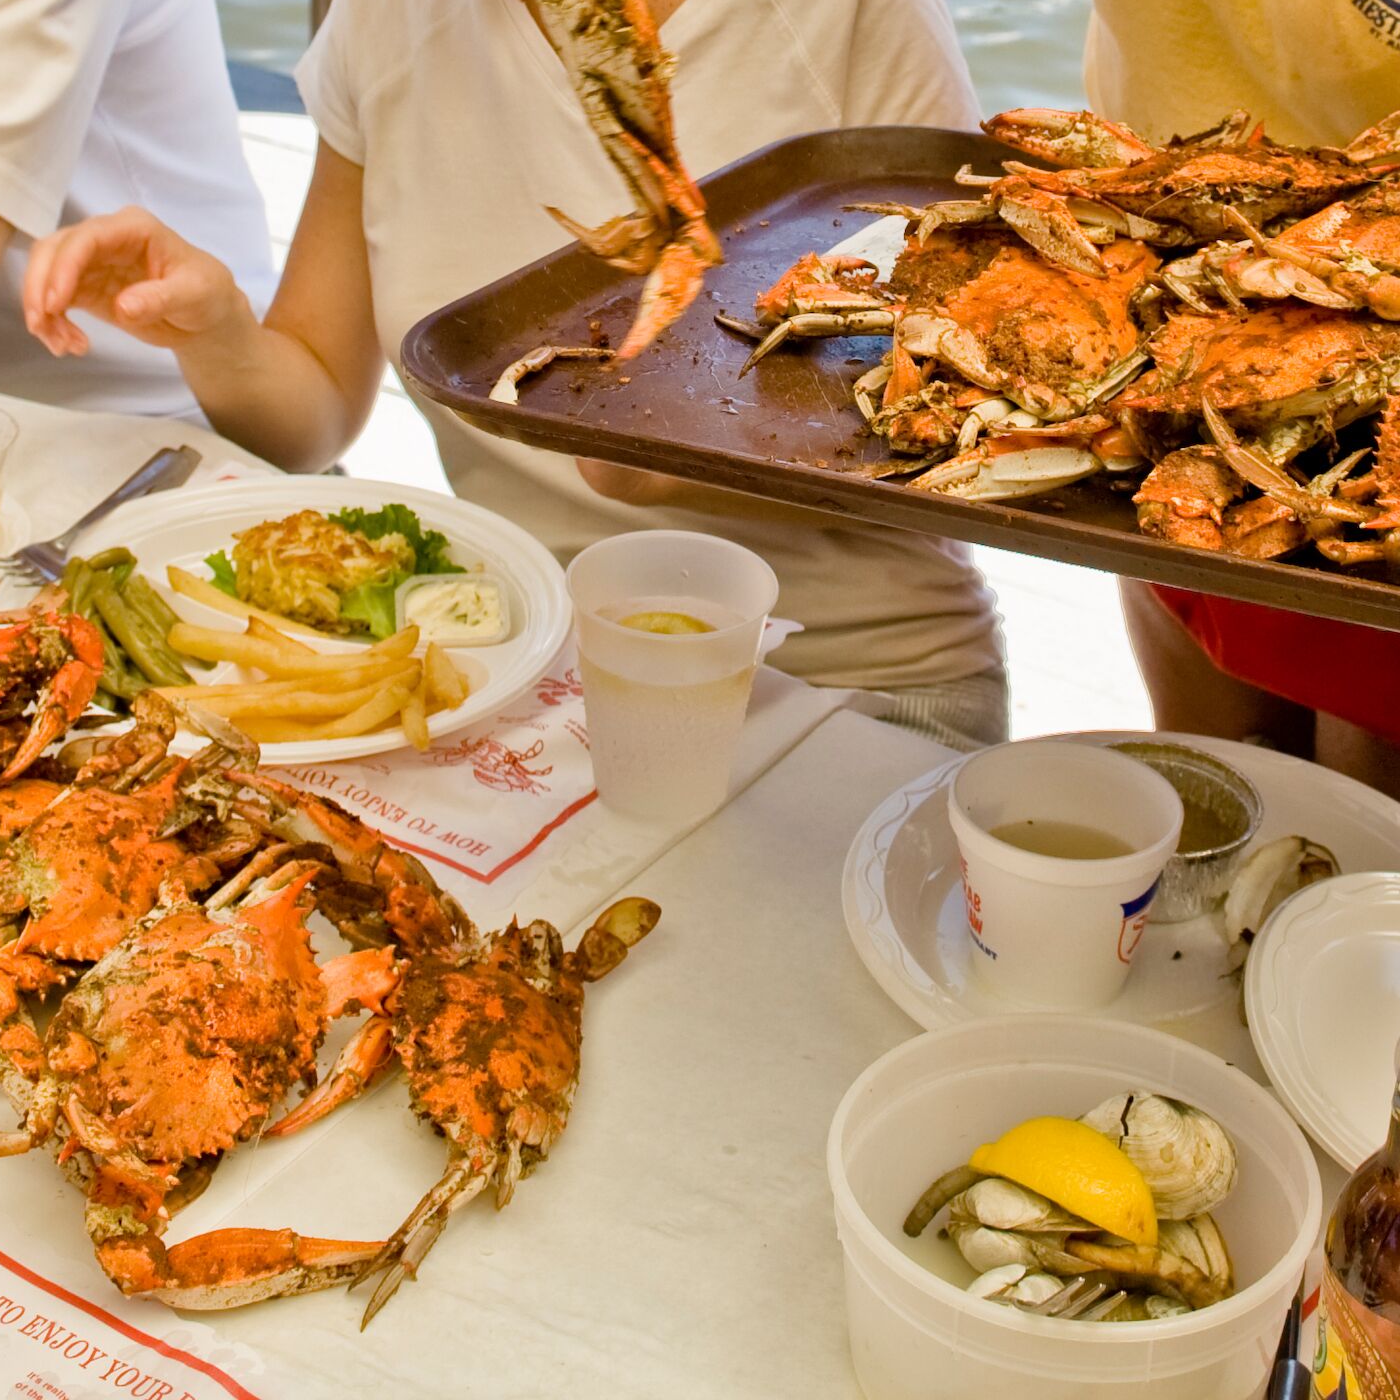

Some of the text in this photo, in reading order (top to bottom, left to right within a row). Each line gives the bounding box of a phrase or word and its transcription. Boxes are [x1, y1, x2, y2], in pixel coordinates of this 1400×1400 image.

[336, 784, 408, 824] ENJOY
[407, 817, 439, 837] TO
[436, 830, 494, 858] HOW
[17, 1314, 108, 1370] ENJOY
[98, 1358, 174, 1400] YOUR
